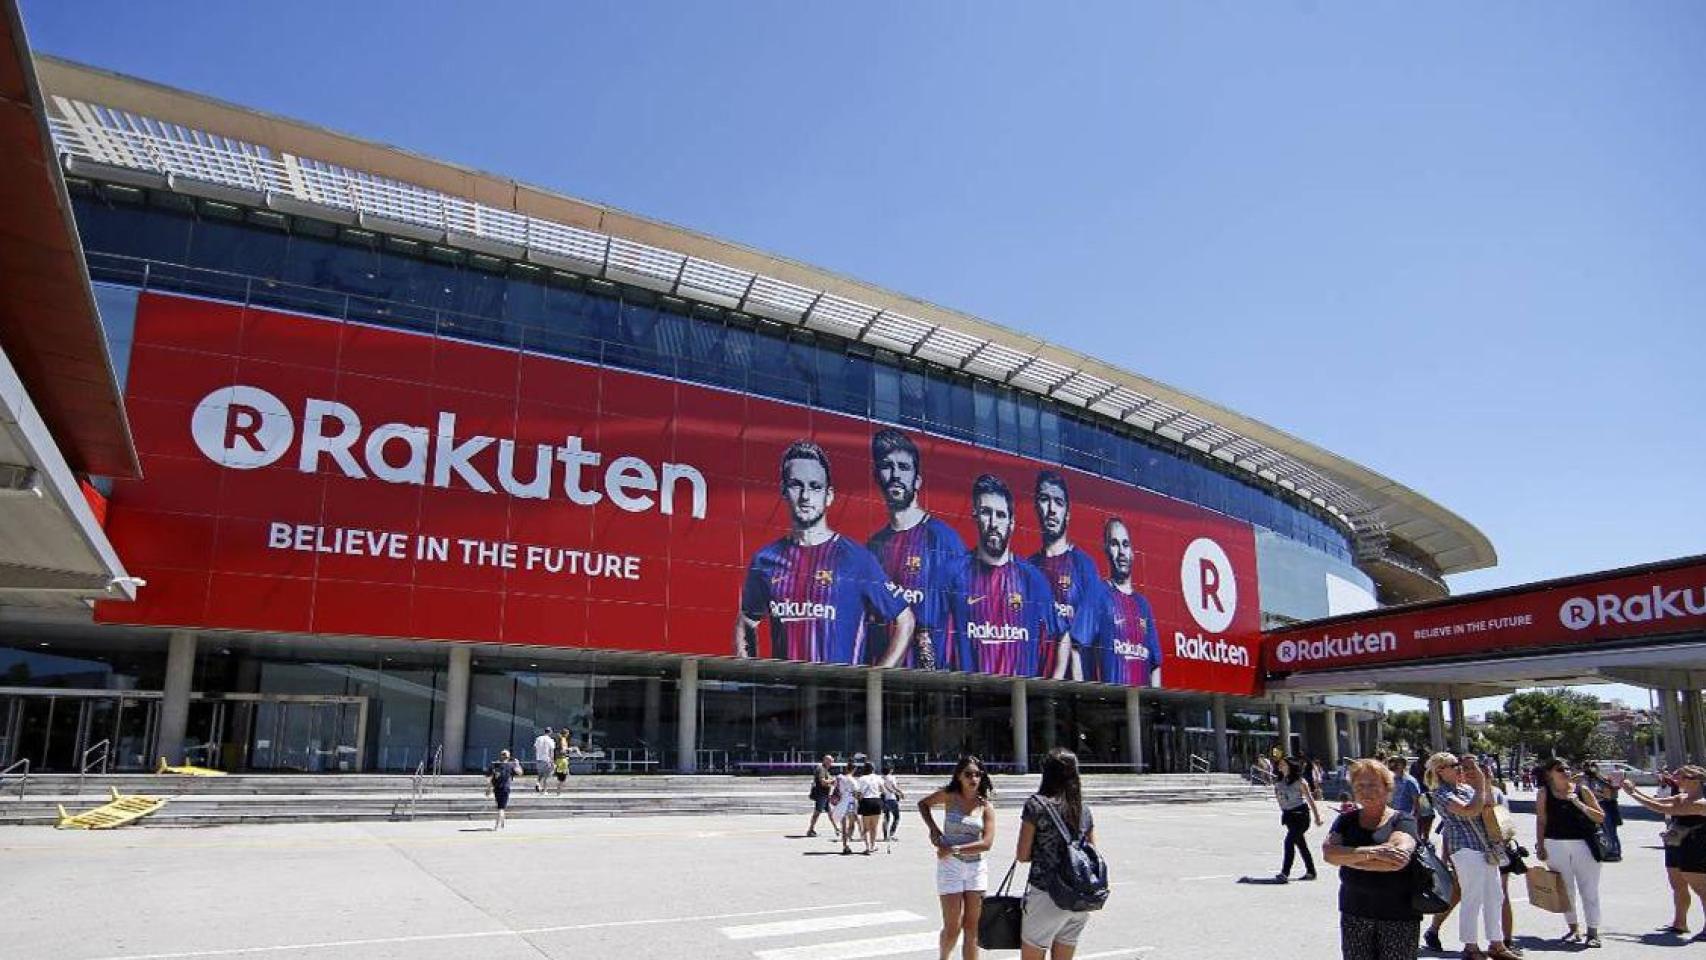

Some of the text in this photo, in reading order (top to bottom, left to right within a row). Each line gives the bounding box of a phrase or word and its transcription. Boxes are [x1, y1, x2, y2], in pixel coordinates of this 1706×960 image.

[300, 397, 708, 519] Rakuten
[268, 521, 641, 580] BELIEVE IN THE FUTURE
[967, 621, 1028, 642] Rakuten
[1414, 614, 1533, 641] BELIEVE IN THE FUTURE
[1175, 631, 1250, 667] Rakuten
[1298, 631, 1397, 661] Rakuten
